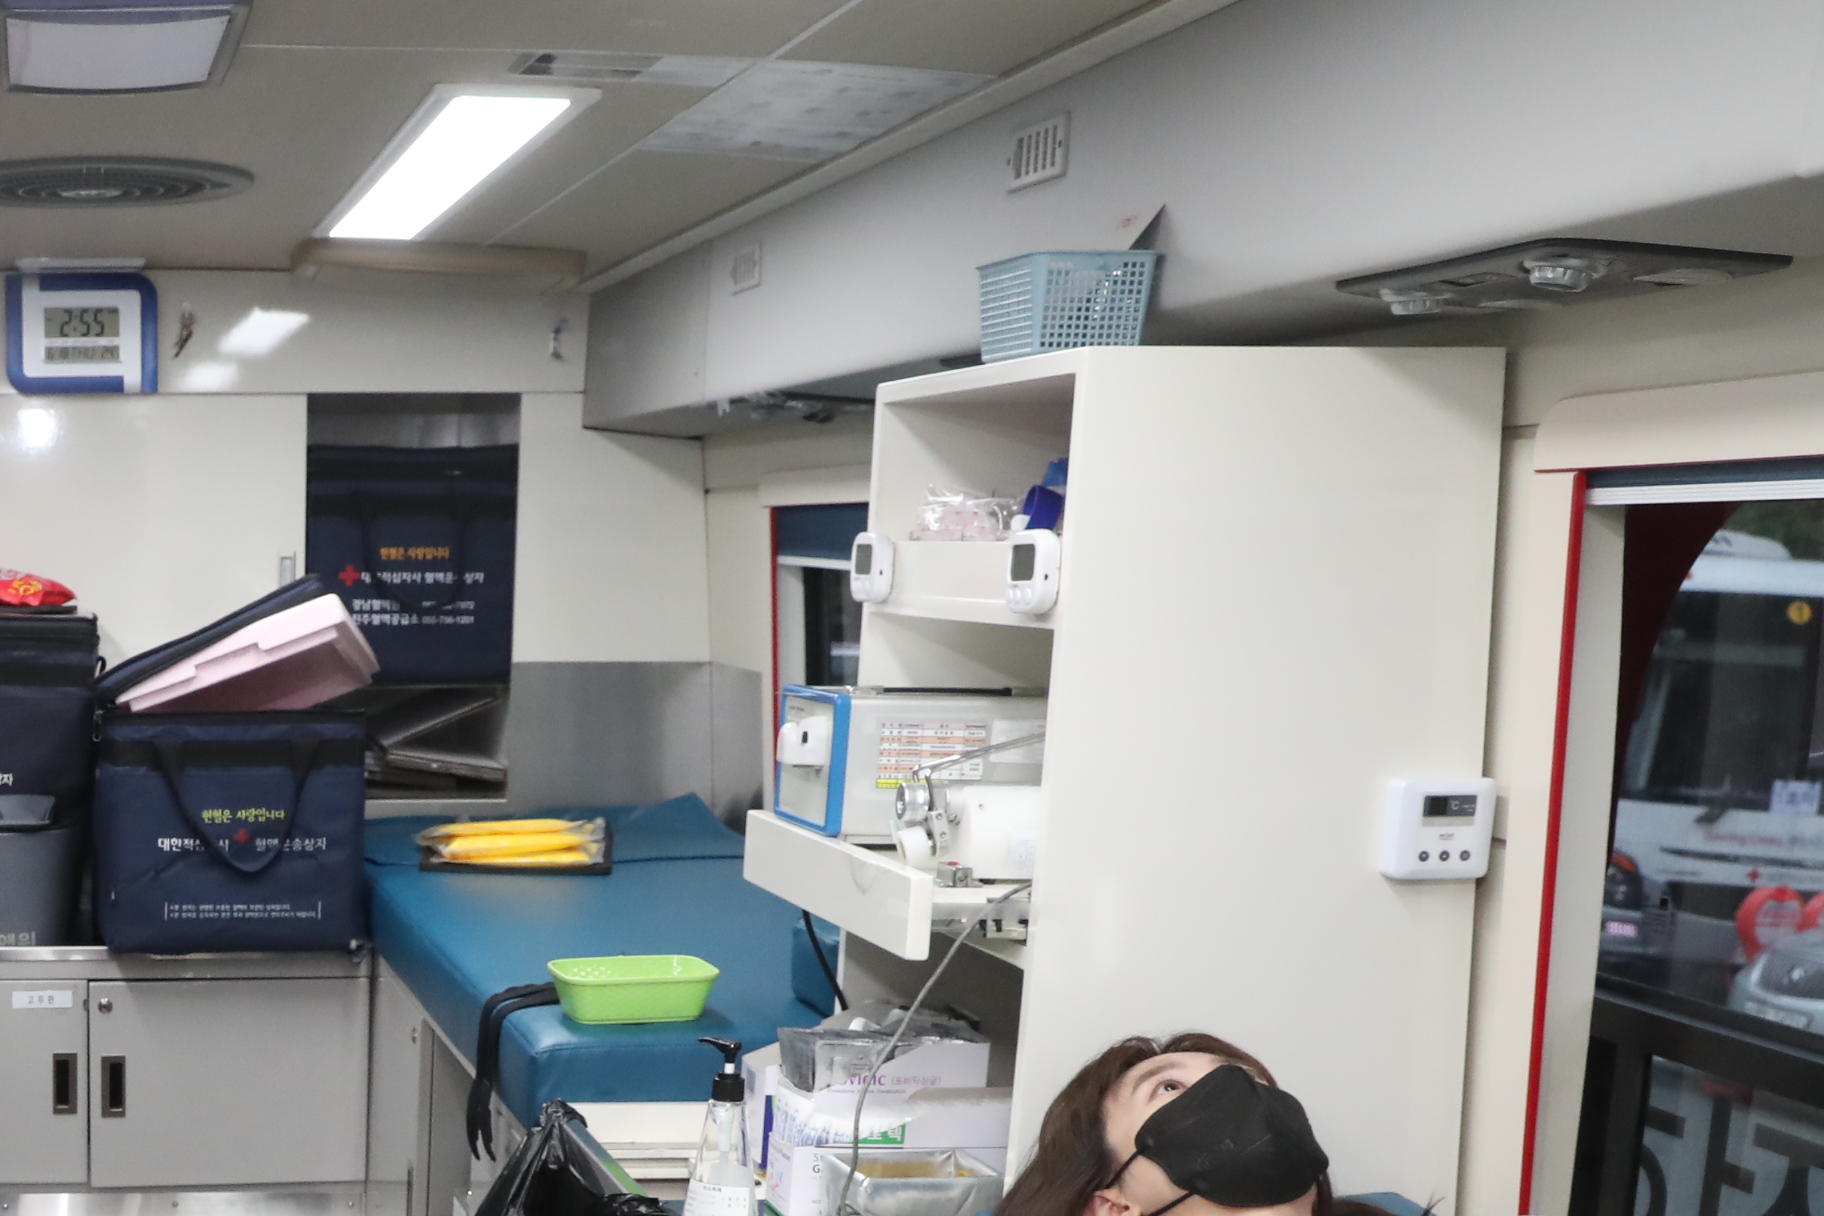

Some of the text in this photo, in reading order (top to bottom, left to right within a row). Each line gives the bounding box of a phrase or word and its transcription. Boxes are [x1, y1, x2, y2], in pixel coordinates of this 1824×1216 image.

[59, 308, 106, 337] 2:55
[360, 571, 485, 585] 대적십자사 혈액운상자
[201, 807, 286, 824] 헌혈은 사랑입니다
[157, 836, 229, 852] 대한적십사
